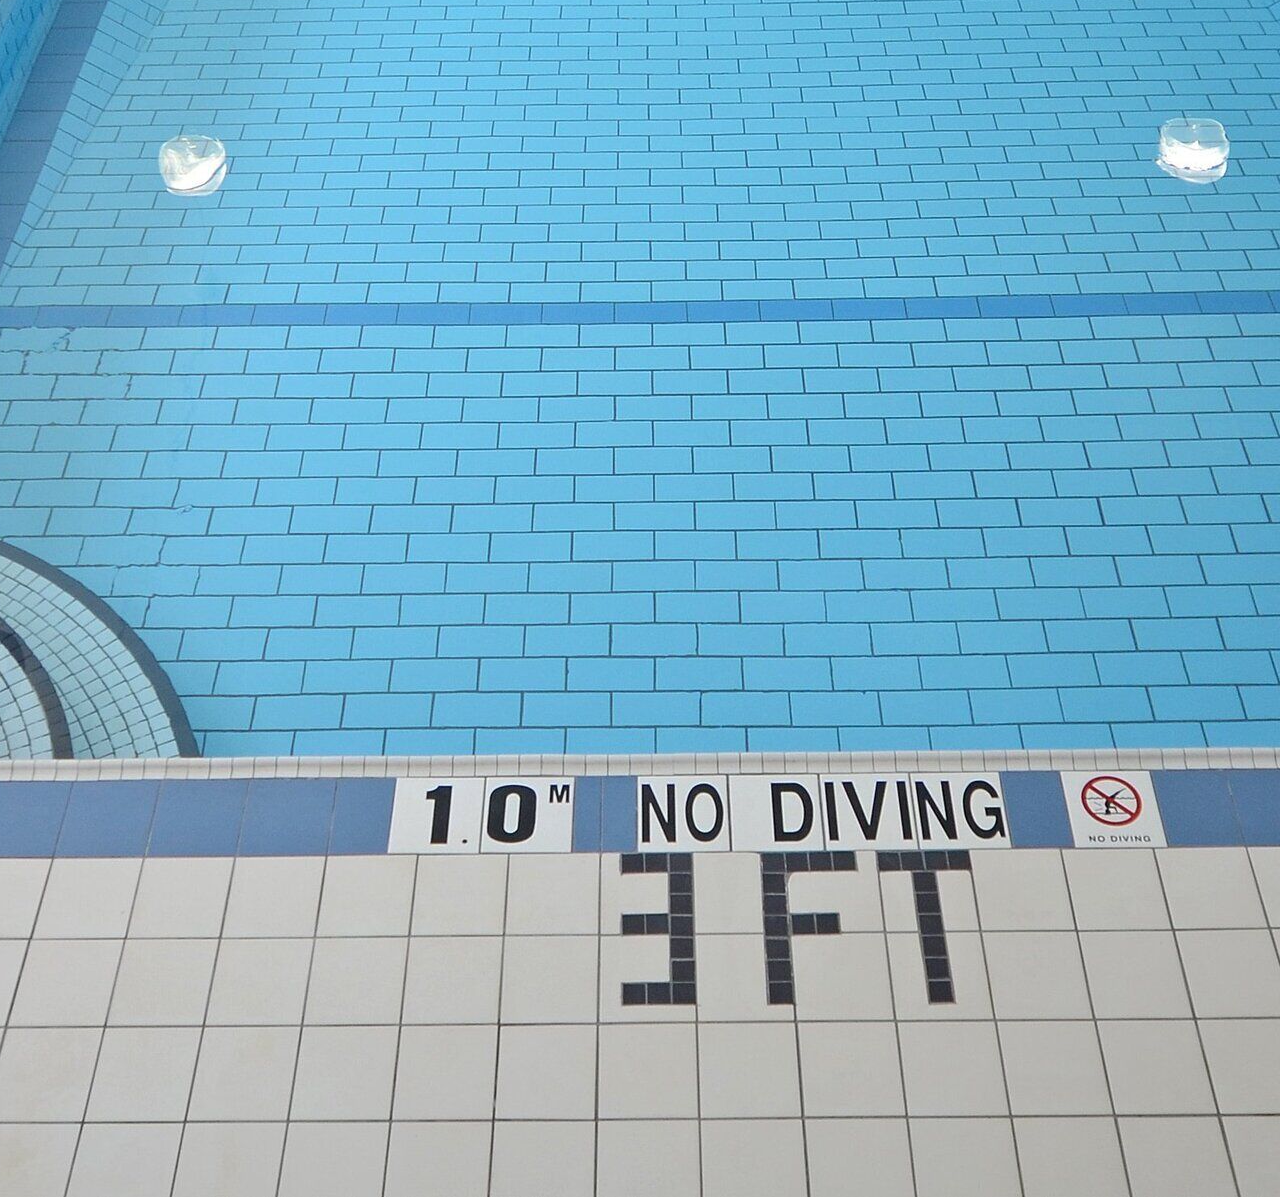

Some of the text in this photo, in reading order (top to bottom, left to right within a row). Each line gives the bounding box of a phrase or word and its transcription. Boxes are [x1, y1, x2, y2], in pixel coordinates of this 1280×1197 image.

[641, 782, 723, 843] NO
[771, 780, 1006, 843] DIVING
[1089, 835, 1151, 843] NO DIVING
[761, 850, 973, 1005] FT
